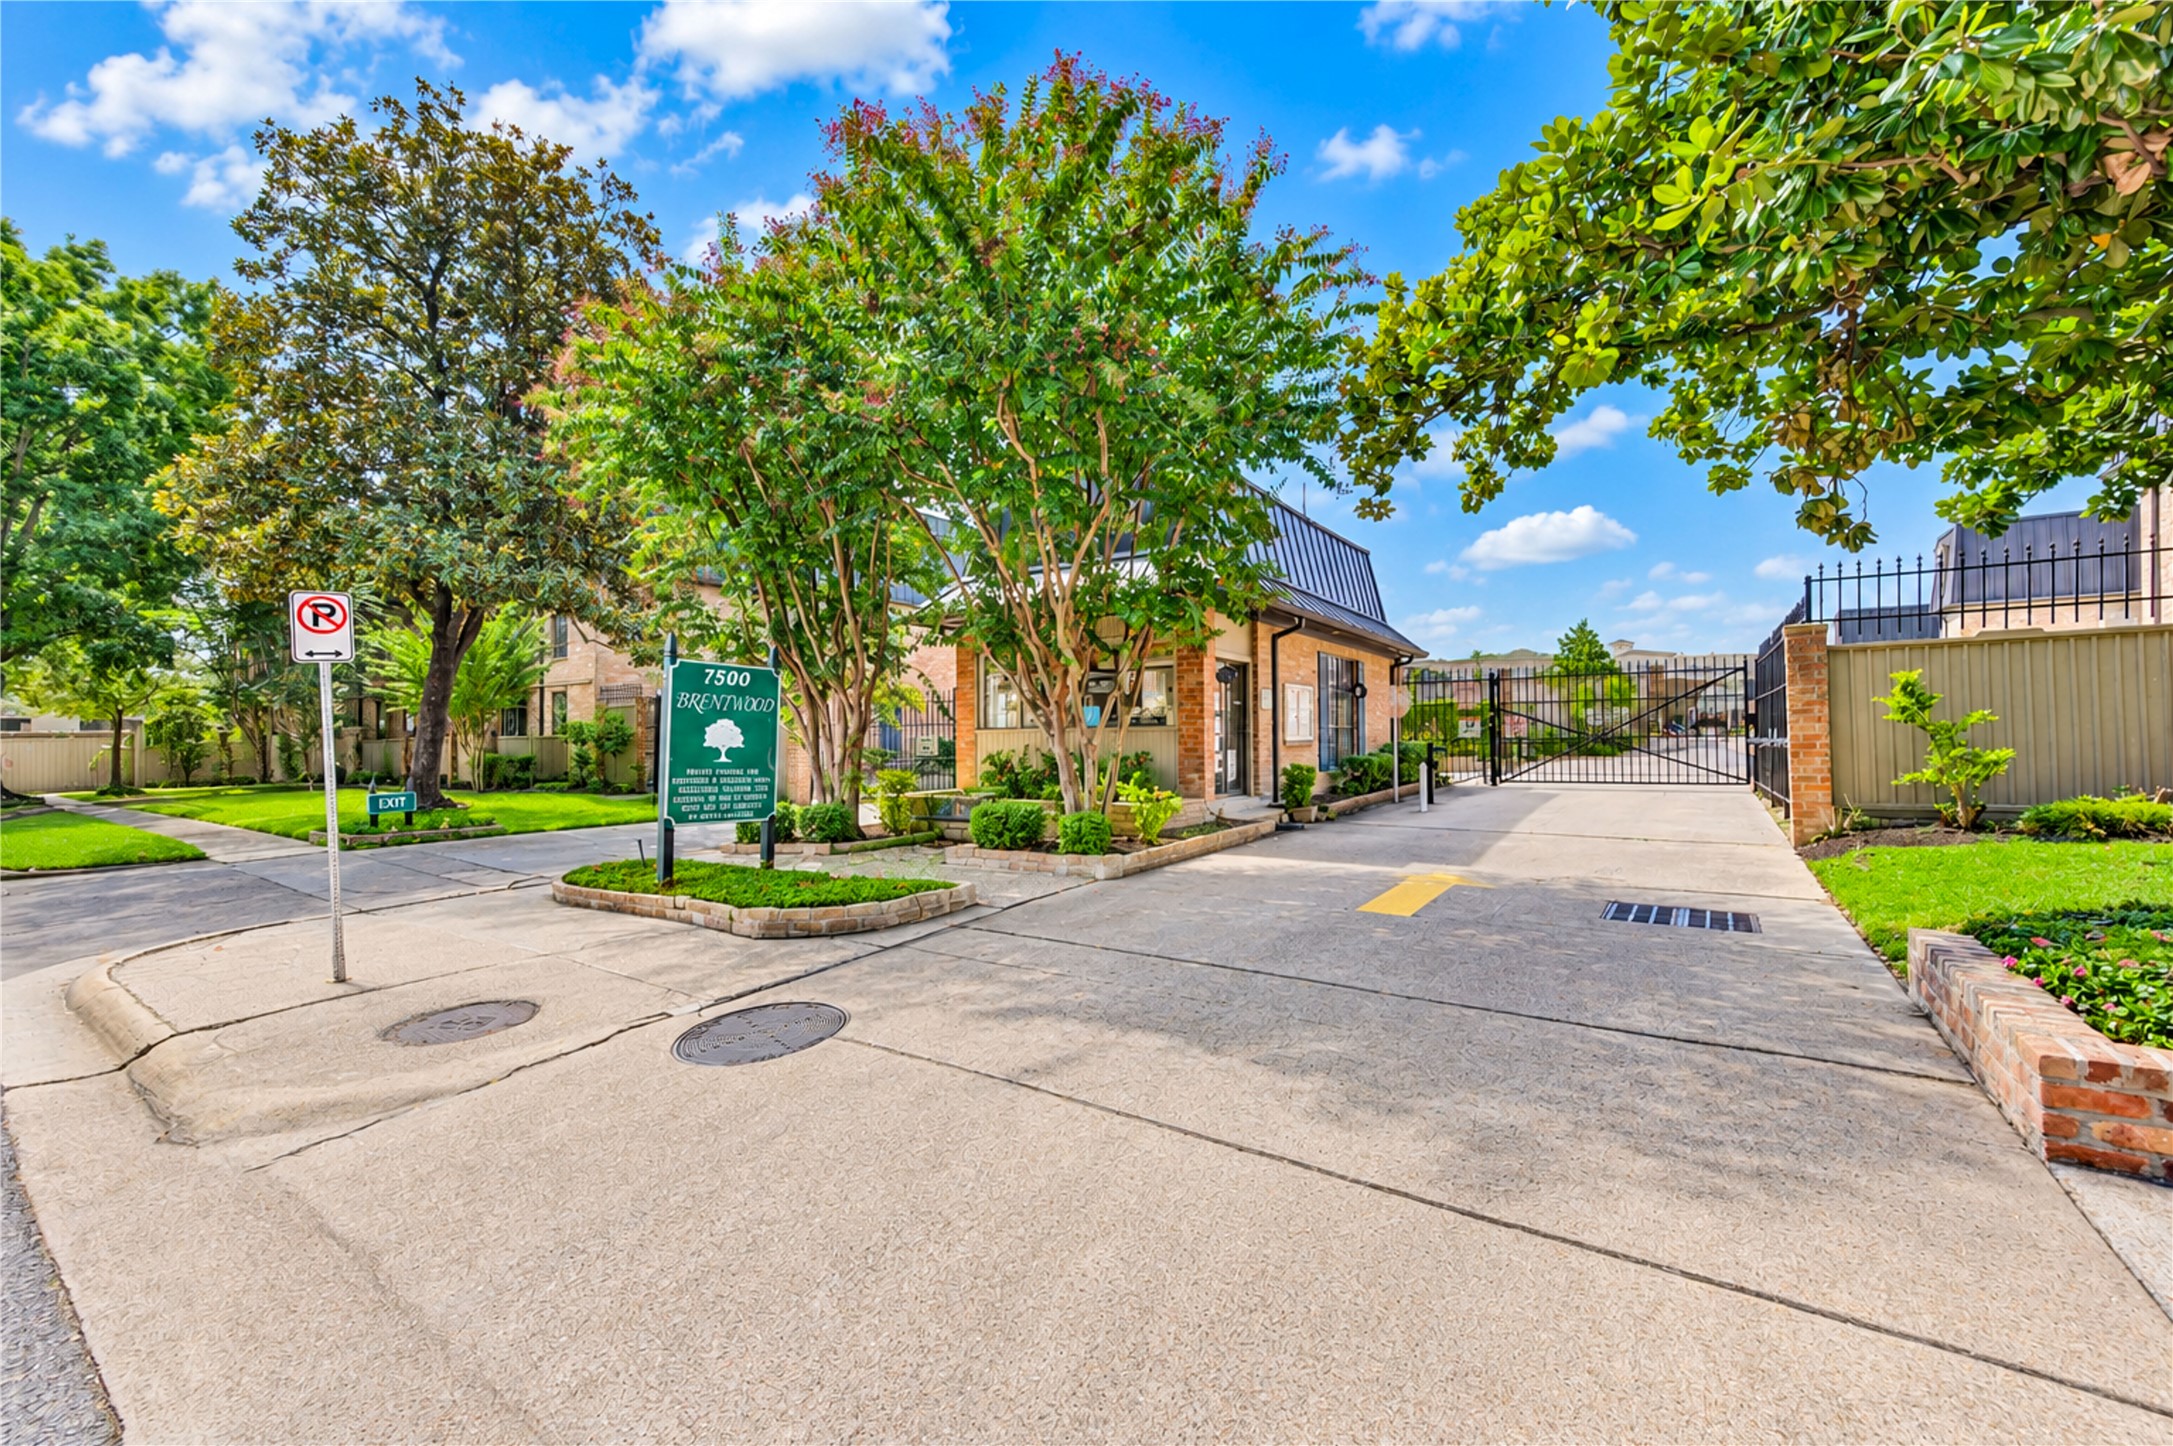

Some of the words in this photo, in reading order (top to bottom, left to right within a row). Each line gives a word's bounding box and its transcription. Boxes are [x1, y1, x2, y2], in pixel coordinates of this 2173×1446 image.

[704, 668, 751, 687] 7500
[676, 691, 775, 715] BRENTWOOD
[378, 796, 407, 810] EXIT
